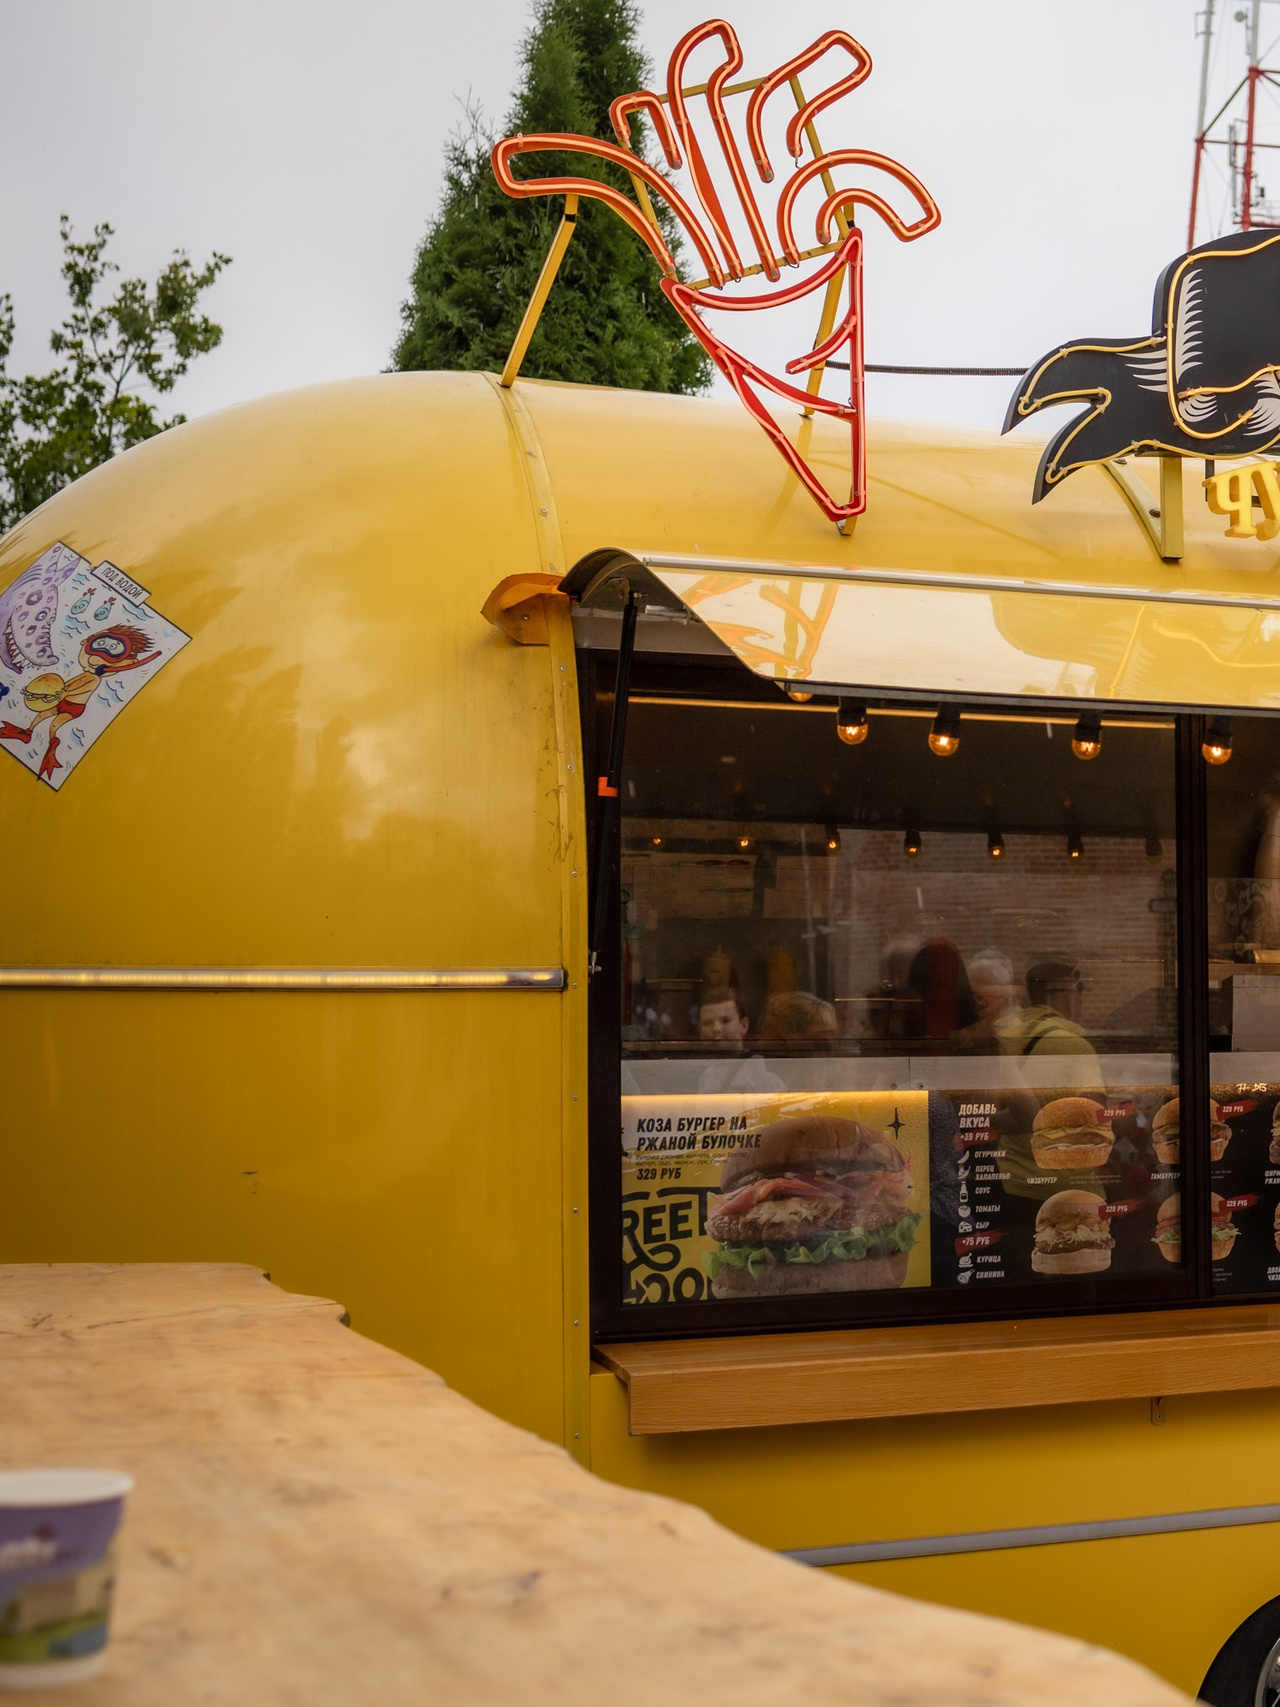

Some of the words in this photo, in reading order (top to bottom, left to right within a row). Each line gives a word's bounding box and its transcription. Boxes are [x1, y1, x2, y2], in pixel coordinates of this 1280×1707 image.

[101, 567, 119, 582] ПОД
[115, 577, 143, 599] ВОДОЙ
[958, 1104, 997, 1116] ДОБАВЬ
[1115, 1108, 1126, 1116] РУБ
[637, 1119, 672, 1133] КОЗА
[677, 1117, 725, 1132] БУРГЕР
[730, 1116, 748, 1130] НА
[960, 1117, 990, 1128] ВКУСА
[975, 1132, 989, 1140] РУБ
[637, 1133, 697, 1151] РЖАНОЙ
[702, 1134, 762, 1149] БУЛОЧКЕ
[974, 1150, 1007, 1158] ОГУРЧИКИ
[975, 1165, 995, 1173] ПЕРЕЦ
[637, 1169, 657, 1180] 329
[661, 1168, 681, 1180] РУБ
[975, 1173, 1011, 1181] ХАЛАПЕНЬО
[975, 1187, 991, 1195] СОУС
[1237, 1199, 1248, 1207] РУБ
[975, 1205, 1001, 1213] ТОМАТЫ
[1117, 1204, 1128, 1212] РУБ
[975, 1236, 990, 1245] РУБ
[976, 1255, 1001, 1264] КУРИЦА
[976, 1270, 1005, 1279] СВИНИНА
